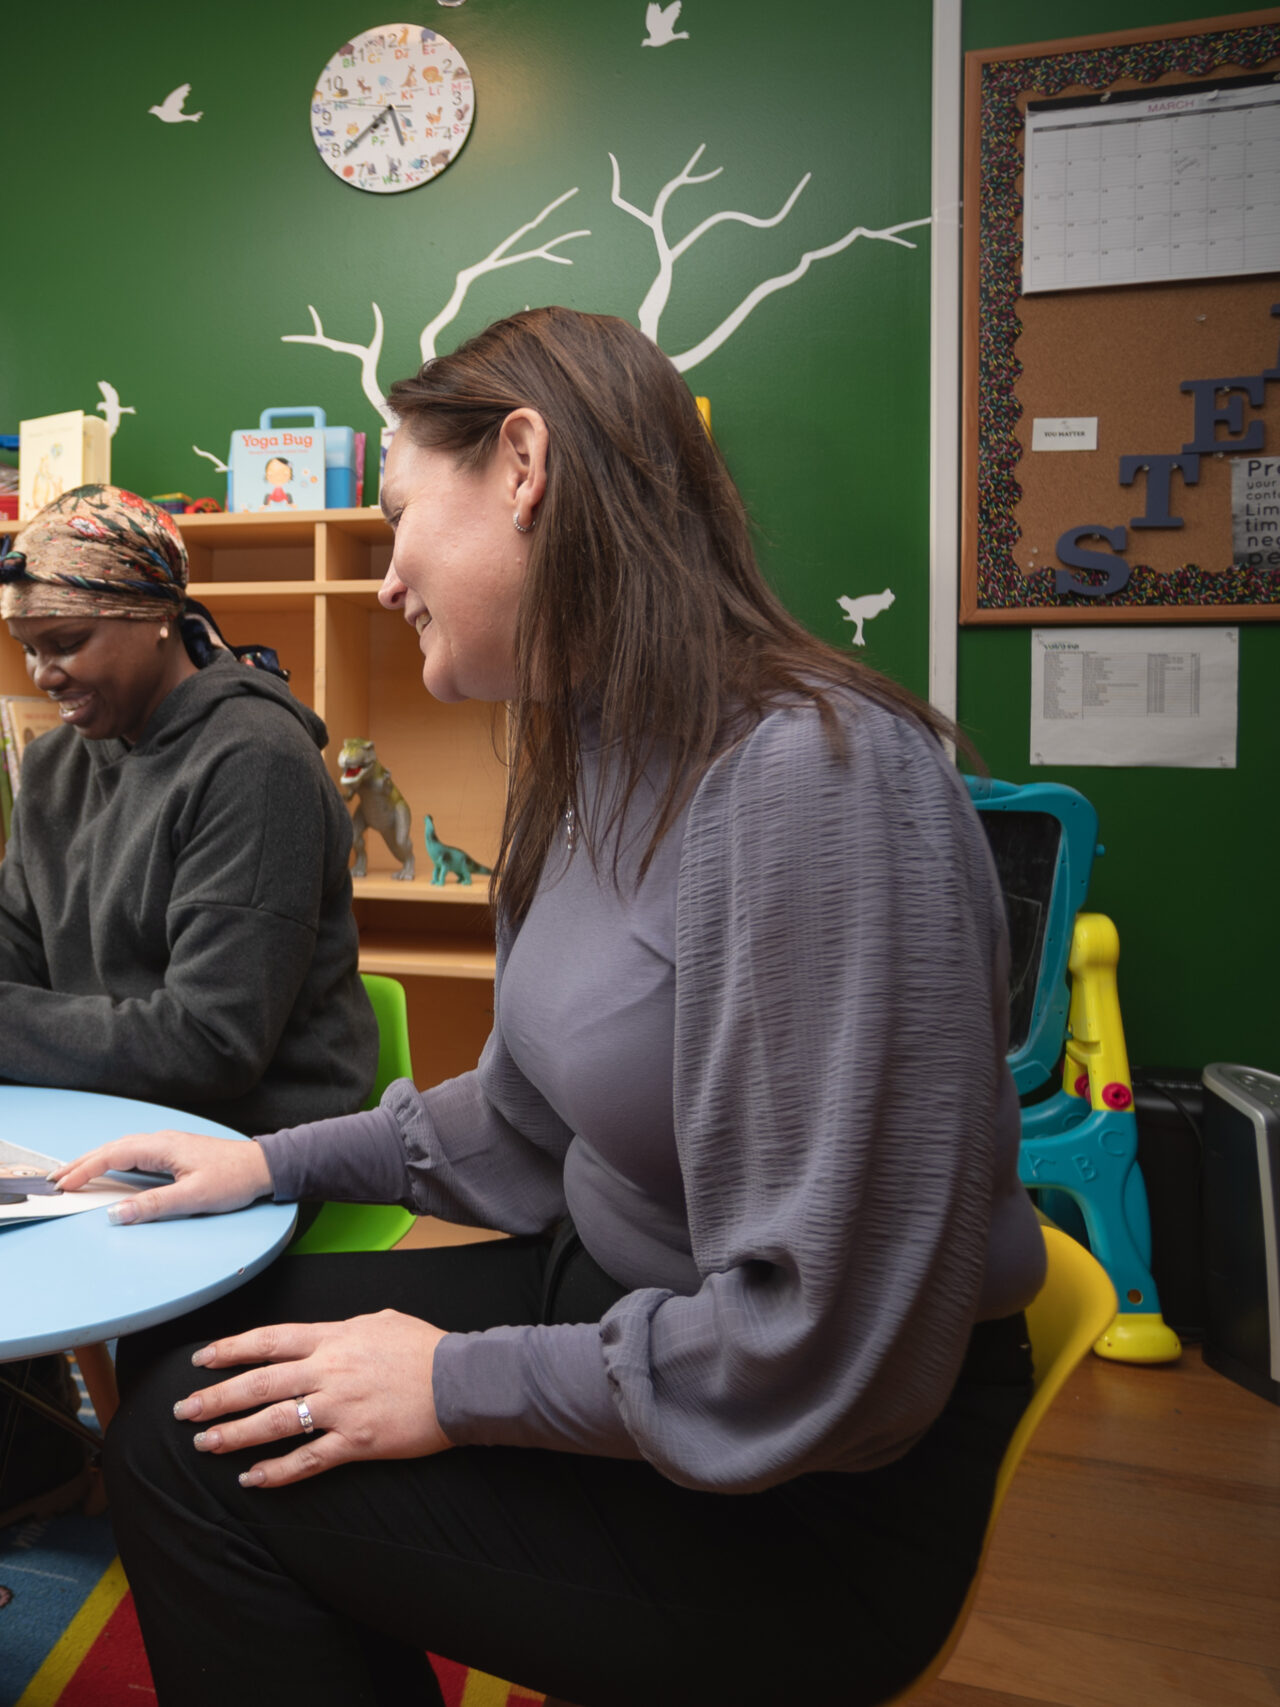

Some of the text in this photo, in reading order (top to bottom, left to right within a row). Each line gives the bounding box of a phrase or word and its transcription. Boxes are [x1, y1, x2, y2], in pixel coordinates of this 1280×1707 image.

[1147, 100, 1194, 113] MARCH
[241, 433, 313, 450] Yoga Bug
[1058, 430, 1086, 438] MATTER
[1248, 460, 1280, 477] Pr
[1247, 480, 1278, 491] your
[1072, 1153, 1097, 1184] B
[1098, 1127, 1127, 1157] C
